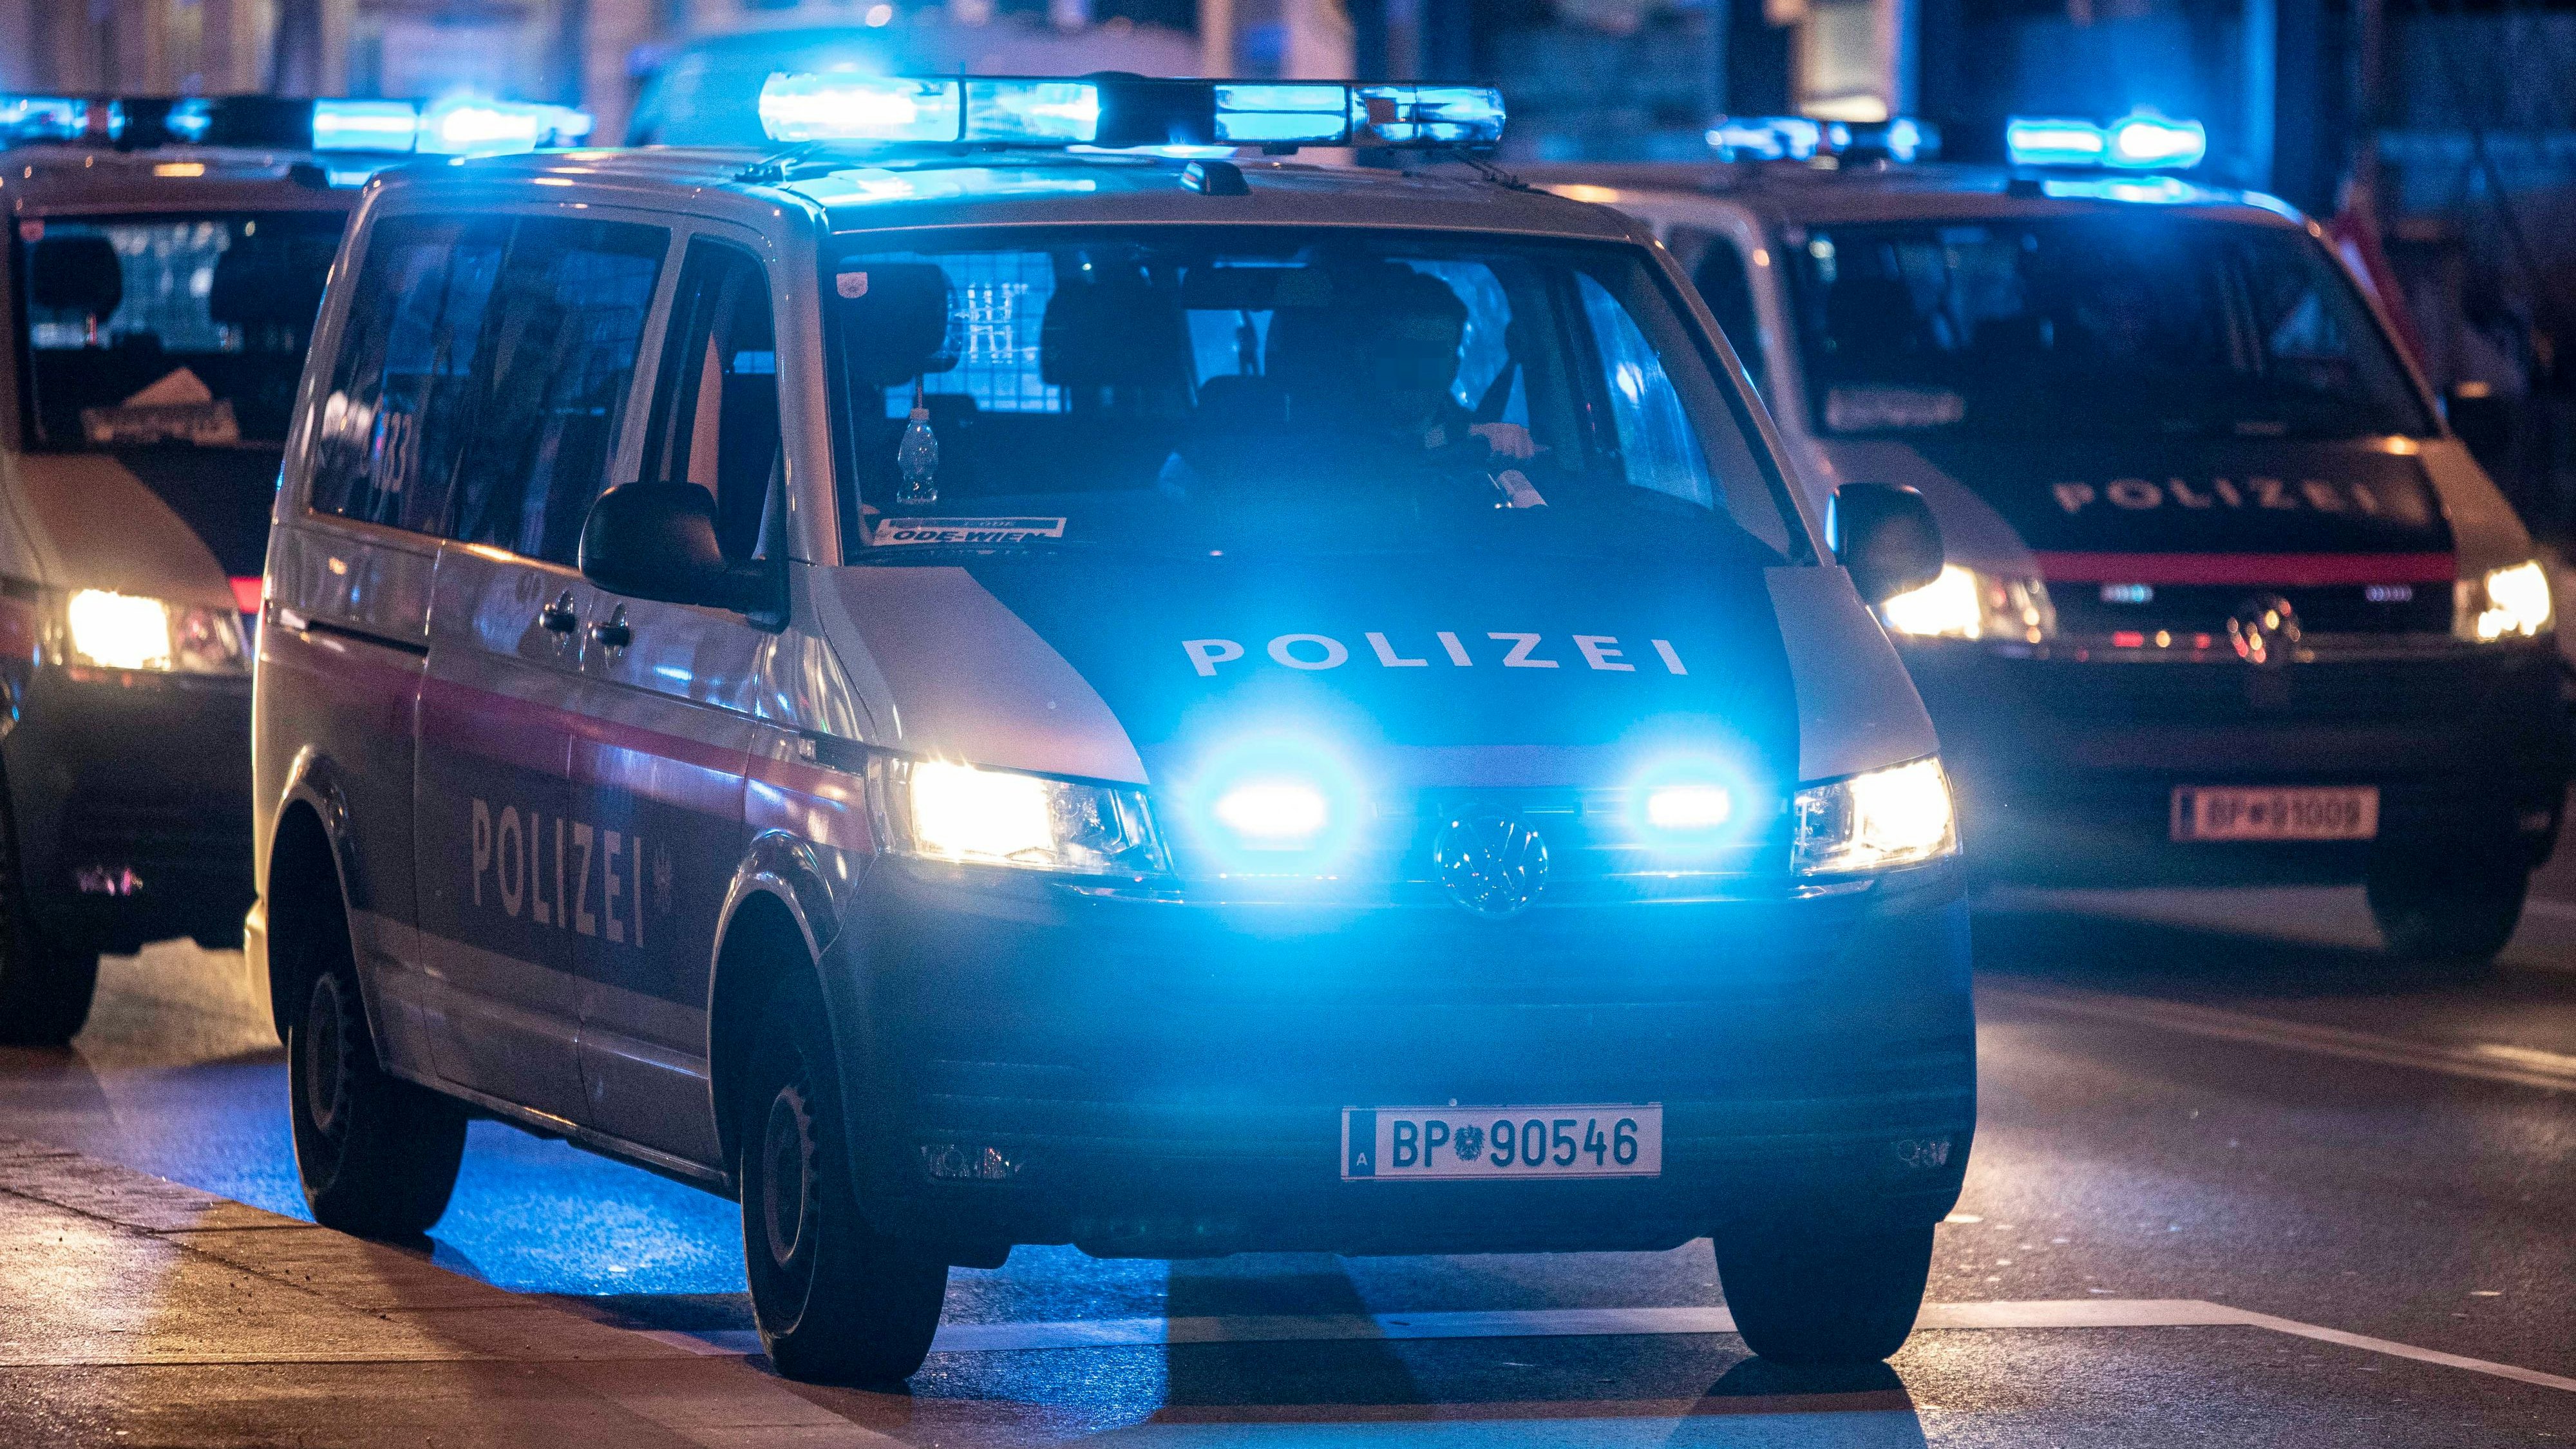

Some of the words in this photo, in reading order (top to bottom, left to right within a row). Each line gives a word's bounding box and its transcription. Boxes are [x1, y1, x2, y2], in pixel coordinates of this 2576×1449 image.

[2052, 477, 2378, 513] POLIZEI
[1182, 631, 1689, 676] POLIZEI
[472, 799, 644, 949] POLIZEI
[1356, 1152, 1368, 1166] A
[1393, 1119, 1450, 1168] BP
[1490, 1118, 1638, 1167] 90546
